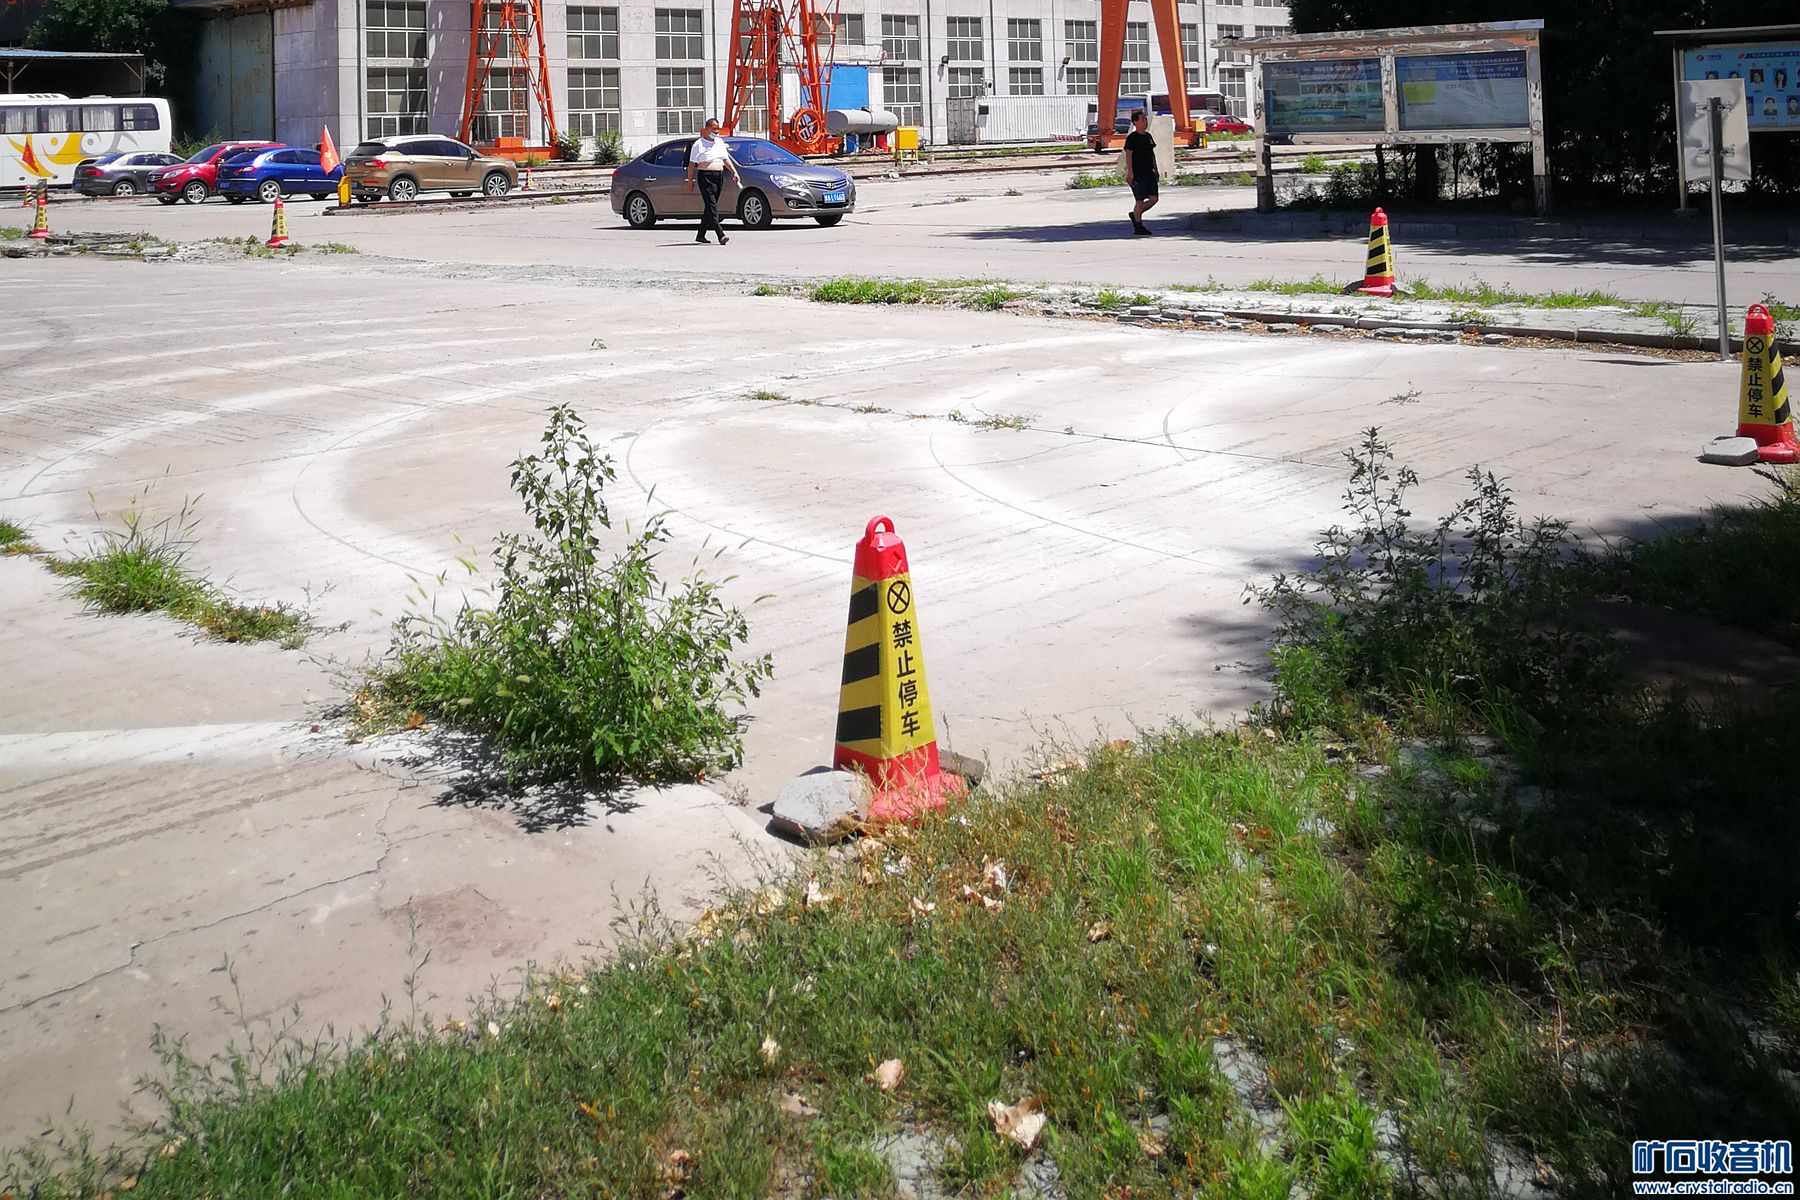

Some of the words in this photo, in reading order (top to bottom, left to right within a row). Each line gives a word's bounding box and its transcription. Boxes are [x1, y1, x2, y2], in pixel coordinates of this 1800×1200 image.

[1747, 357, 1763, 418] 禁止停车
[892, 618, 921, 738] 禁止停车
